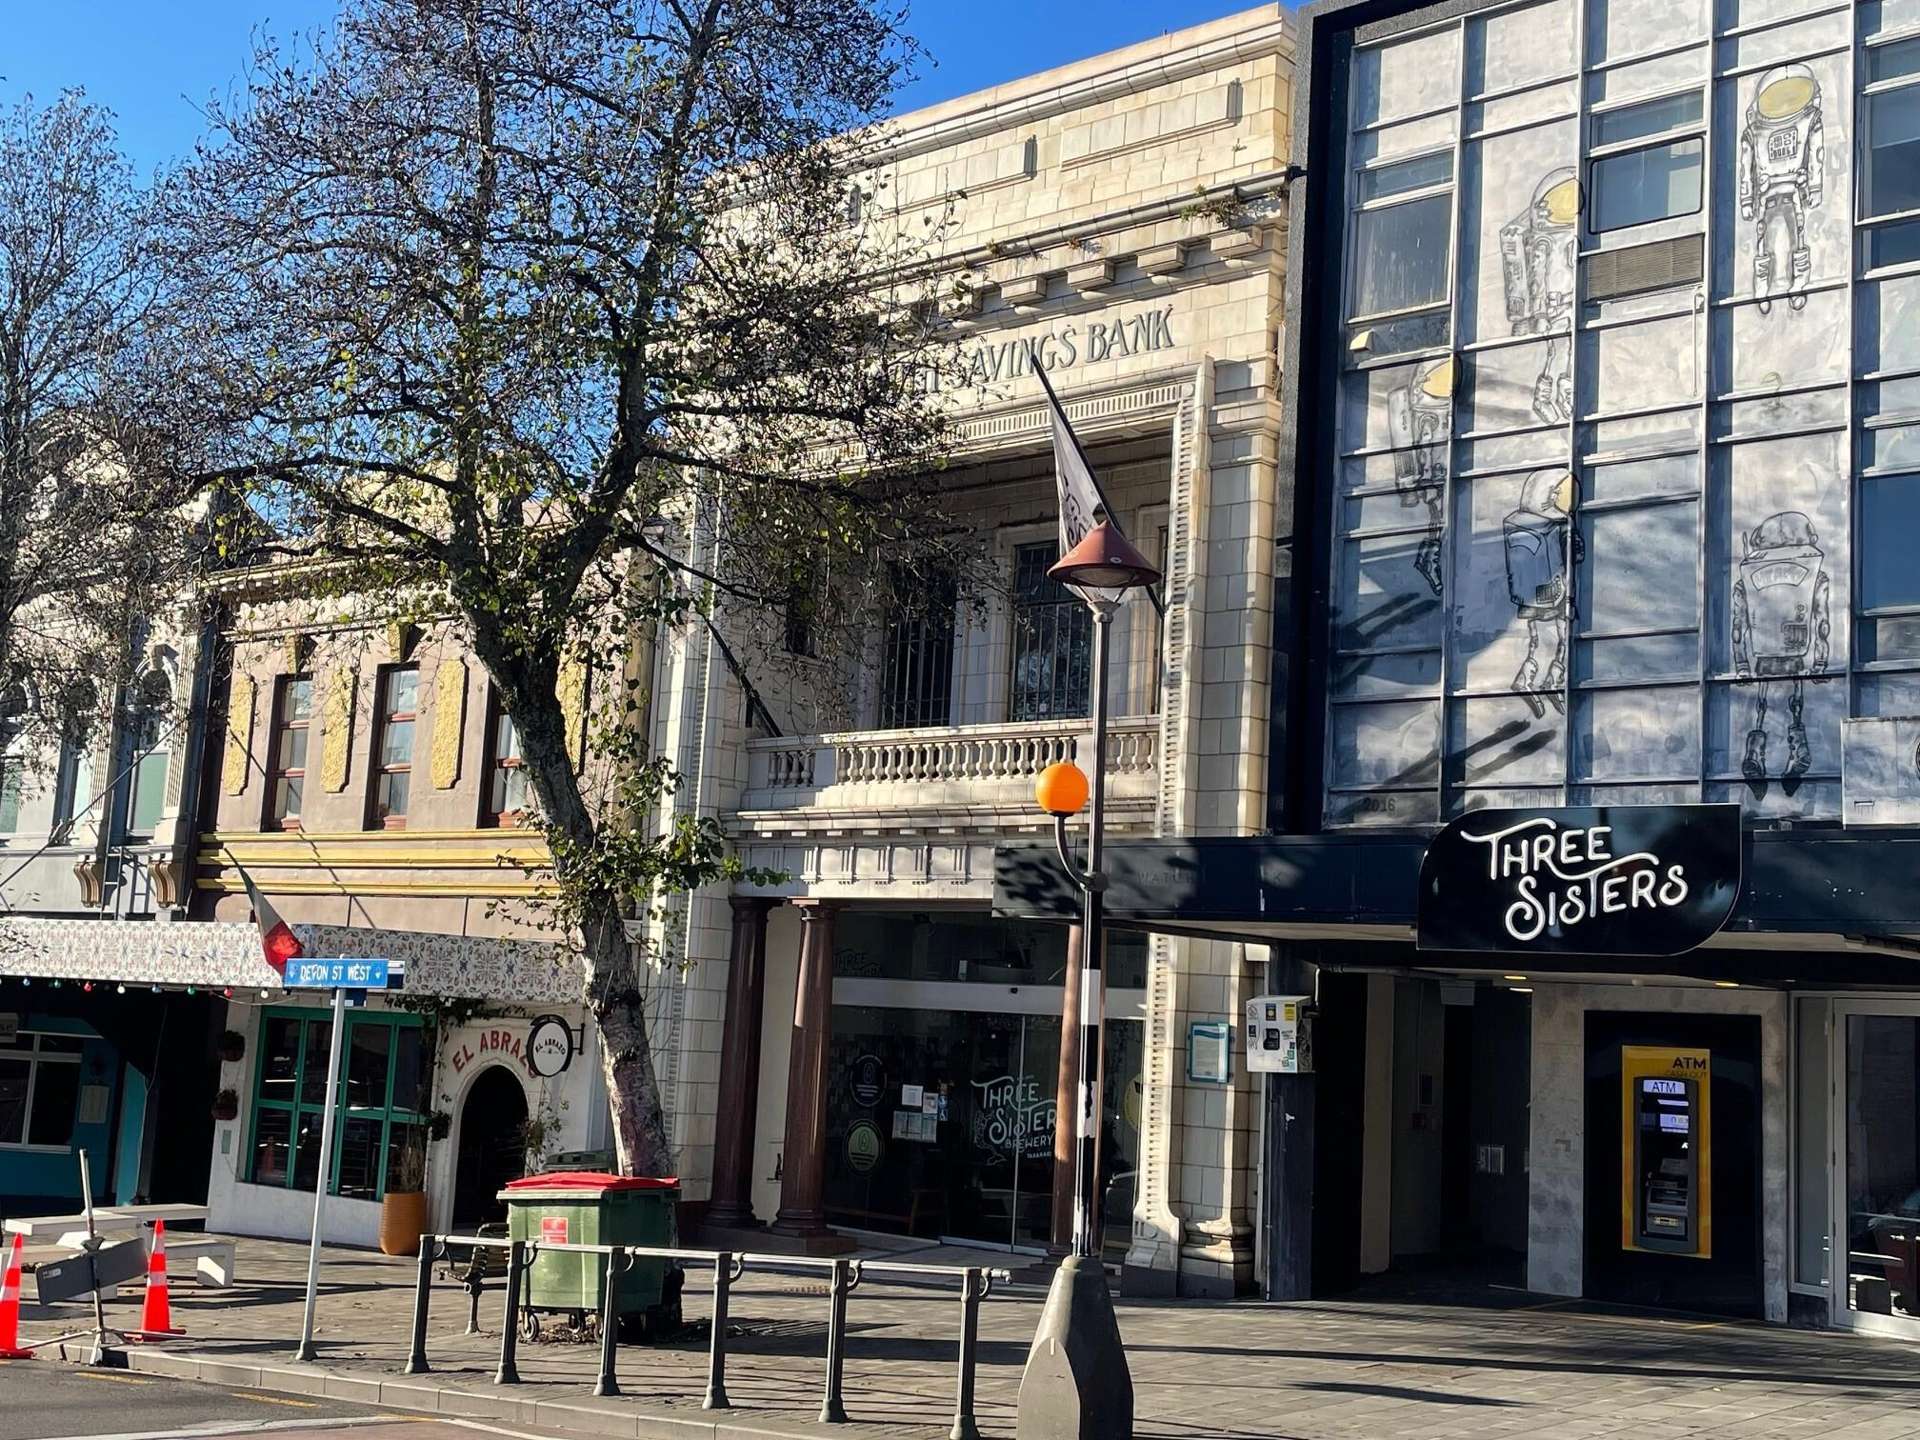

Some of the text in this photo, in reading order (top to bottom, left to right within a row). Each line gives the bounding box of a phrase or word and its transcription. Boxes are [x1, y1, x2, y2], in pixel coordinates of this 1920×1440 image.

[1086, 304, 1175, 363] BANK
[1460, 817, 1613, 881] THREE
[1504, 853, 1689, 941] SISTERS
[300, 964, 372, 980] DEVON ST WEST
[453, 1045, 474, 1073] EL
[535, 1043, 543, 1053] EL
[1672, 1057, 1706, 1070] ATM
[970, 1075, 1040, 1109] THREE
[1652, 1081, 1676, 1093] ATM
[989, 1099, 1057, 1144] SISTER
